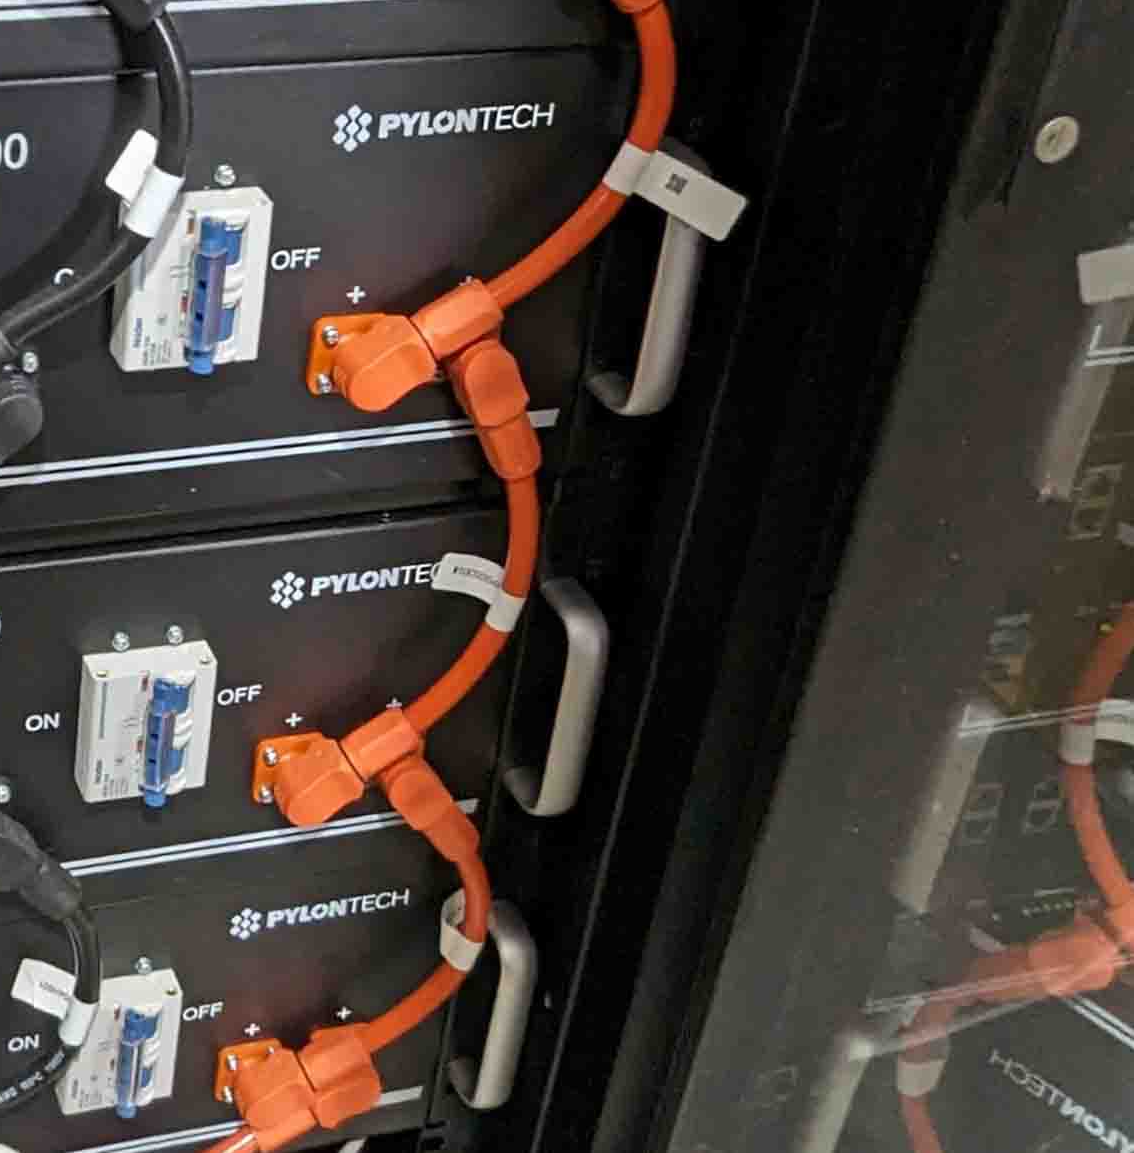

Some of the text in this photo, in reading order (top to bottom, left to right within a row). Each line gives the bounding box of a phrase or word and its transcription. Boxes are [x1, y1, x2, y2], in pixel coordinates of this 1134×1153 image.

[377, 102, 556, 142] PYLONTECH
[271, 248, 321, 272] OFF
[310, 563, 440, 597] PYLONTE
[217, 684, 262, 707] OFF
[24, 713, 61, 733] ON
[266, 888, 411, 929] PYLONTECH
[183, 1002, 223, 1021] OFF
[7, 1033, 40, 1052] ON
